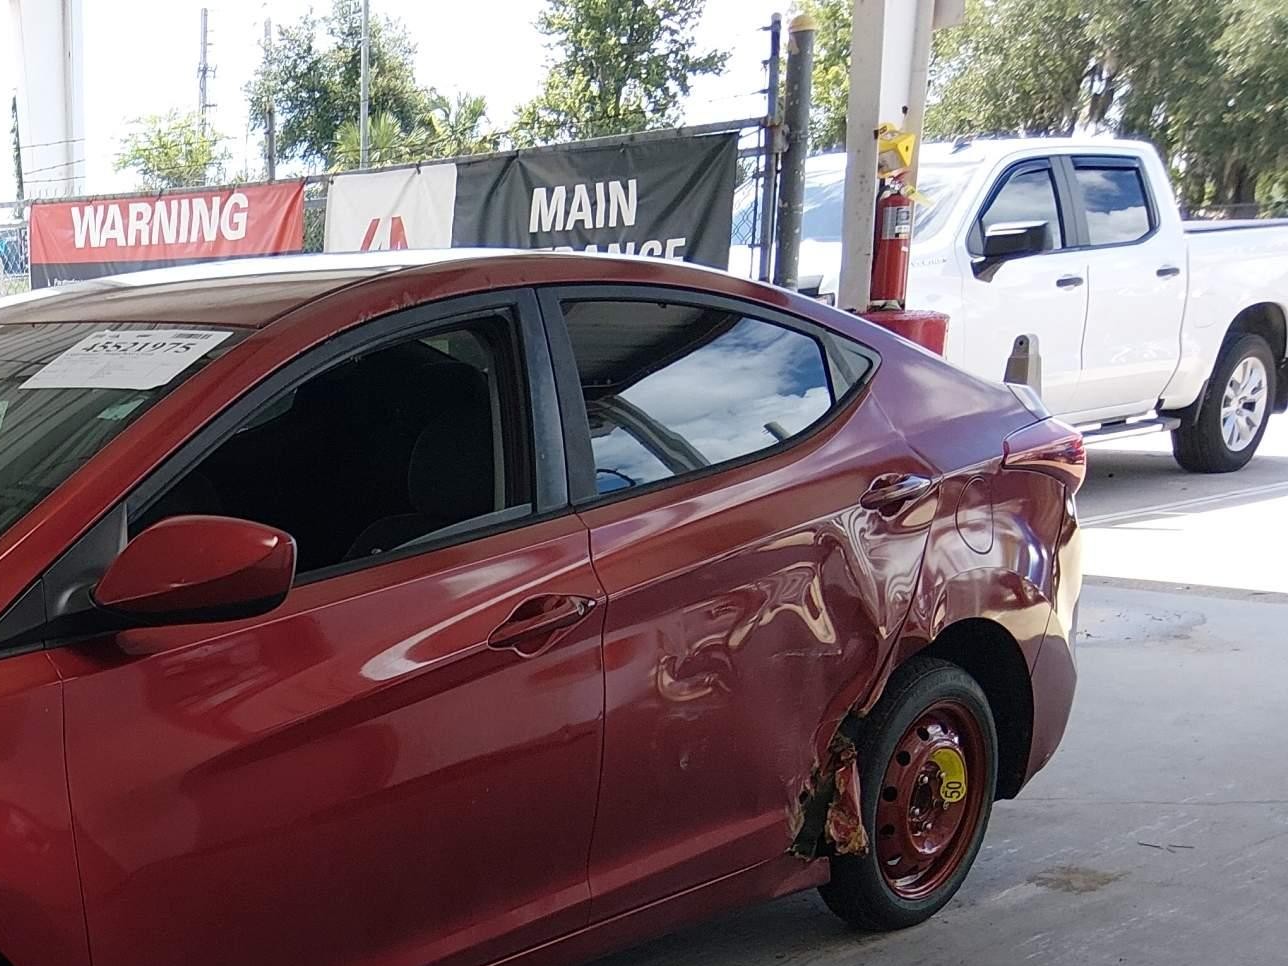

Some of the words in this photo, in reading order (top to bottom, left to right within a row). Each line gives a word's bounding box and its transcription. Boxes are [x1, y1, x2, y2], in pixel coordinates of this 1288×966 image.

[71, 193, 249, 249] WARNING
[529, 179, 638, 232] MAIN
[81, 341, 197, 354] 45521975
[945, 781, 962, 799] 50
